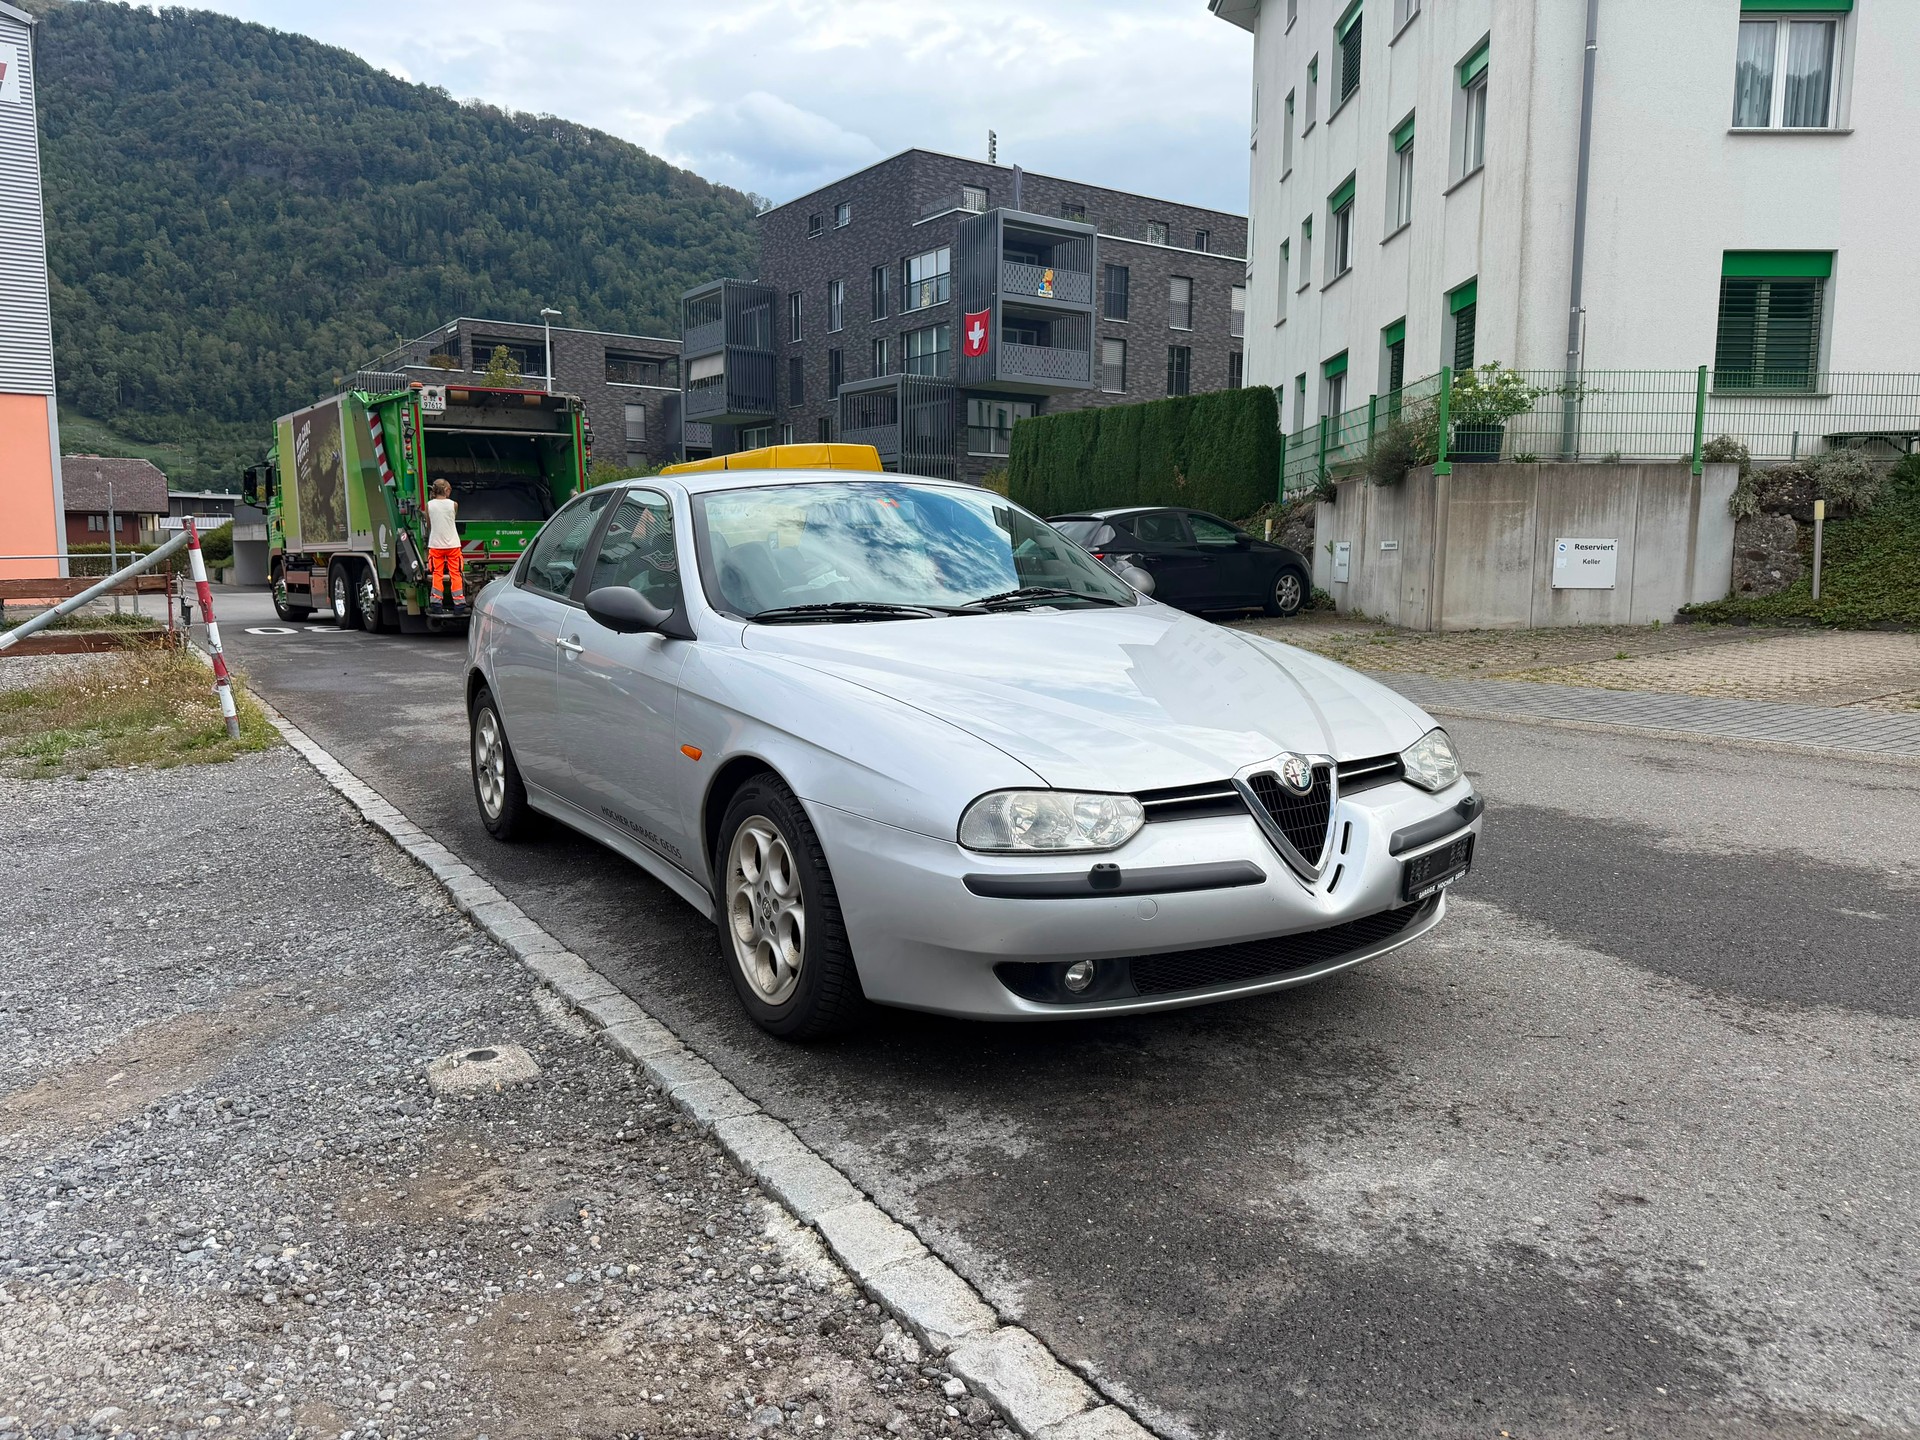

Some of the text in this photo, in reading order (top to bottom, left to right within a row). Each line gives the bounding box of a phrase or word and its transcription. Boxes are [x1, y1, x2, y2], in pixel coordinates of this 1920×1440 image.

[423, 401, 443, 409] 97612
[1574, 543, 1614, 551] Reserviert
[601, 805, 682, 859] HOCHER GARAGE GEISS
[1418, 885, 1436, 899] GARAGE
